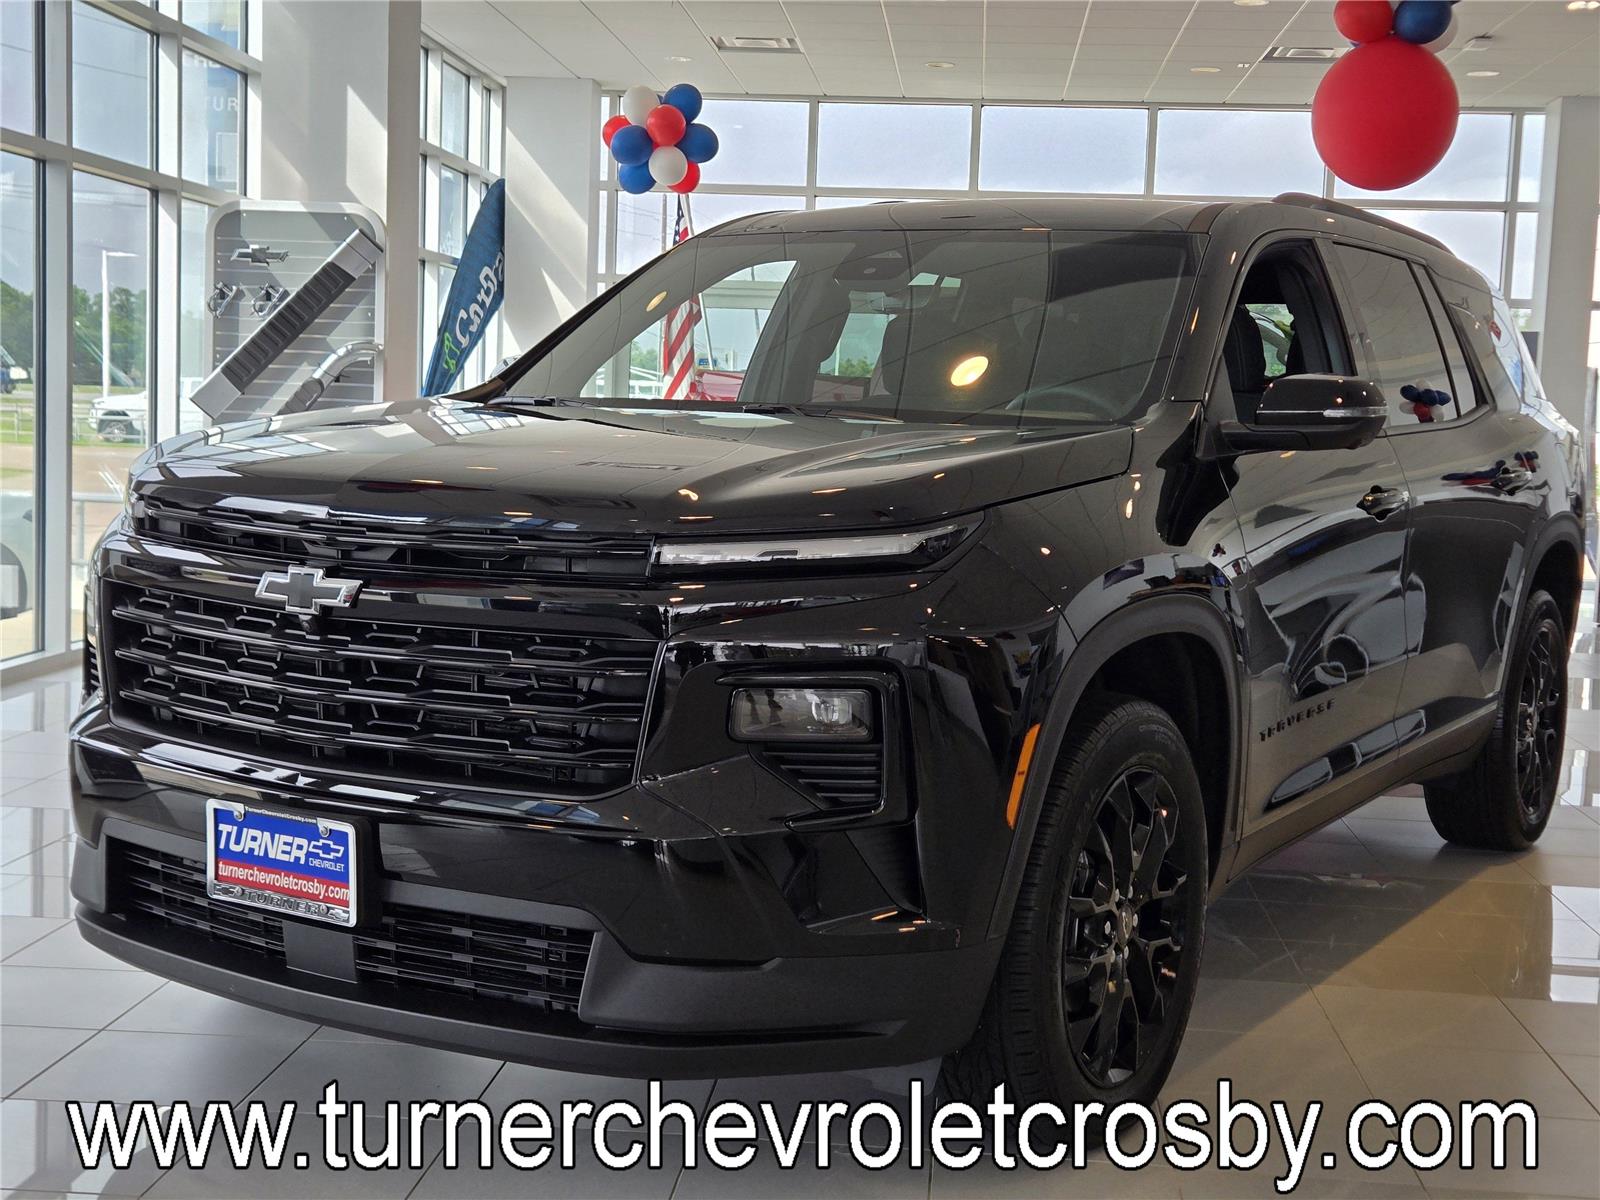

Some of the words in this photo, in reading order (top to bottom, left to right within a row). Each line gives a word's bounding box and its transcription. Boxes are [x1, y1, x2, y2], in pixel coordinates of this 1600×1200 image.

[218, 823, 309, 865] TURNER
[218, 861, 350, 901] turnerchevroletcrosby.com
[309, 858, 345, 873] CHEVROLET
[245, 891, 320, 914] TURNER
